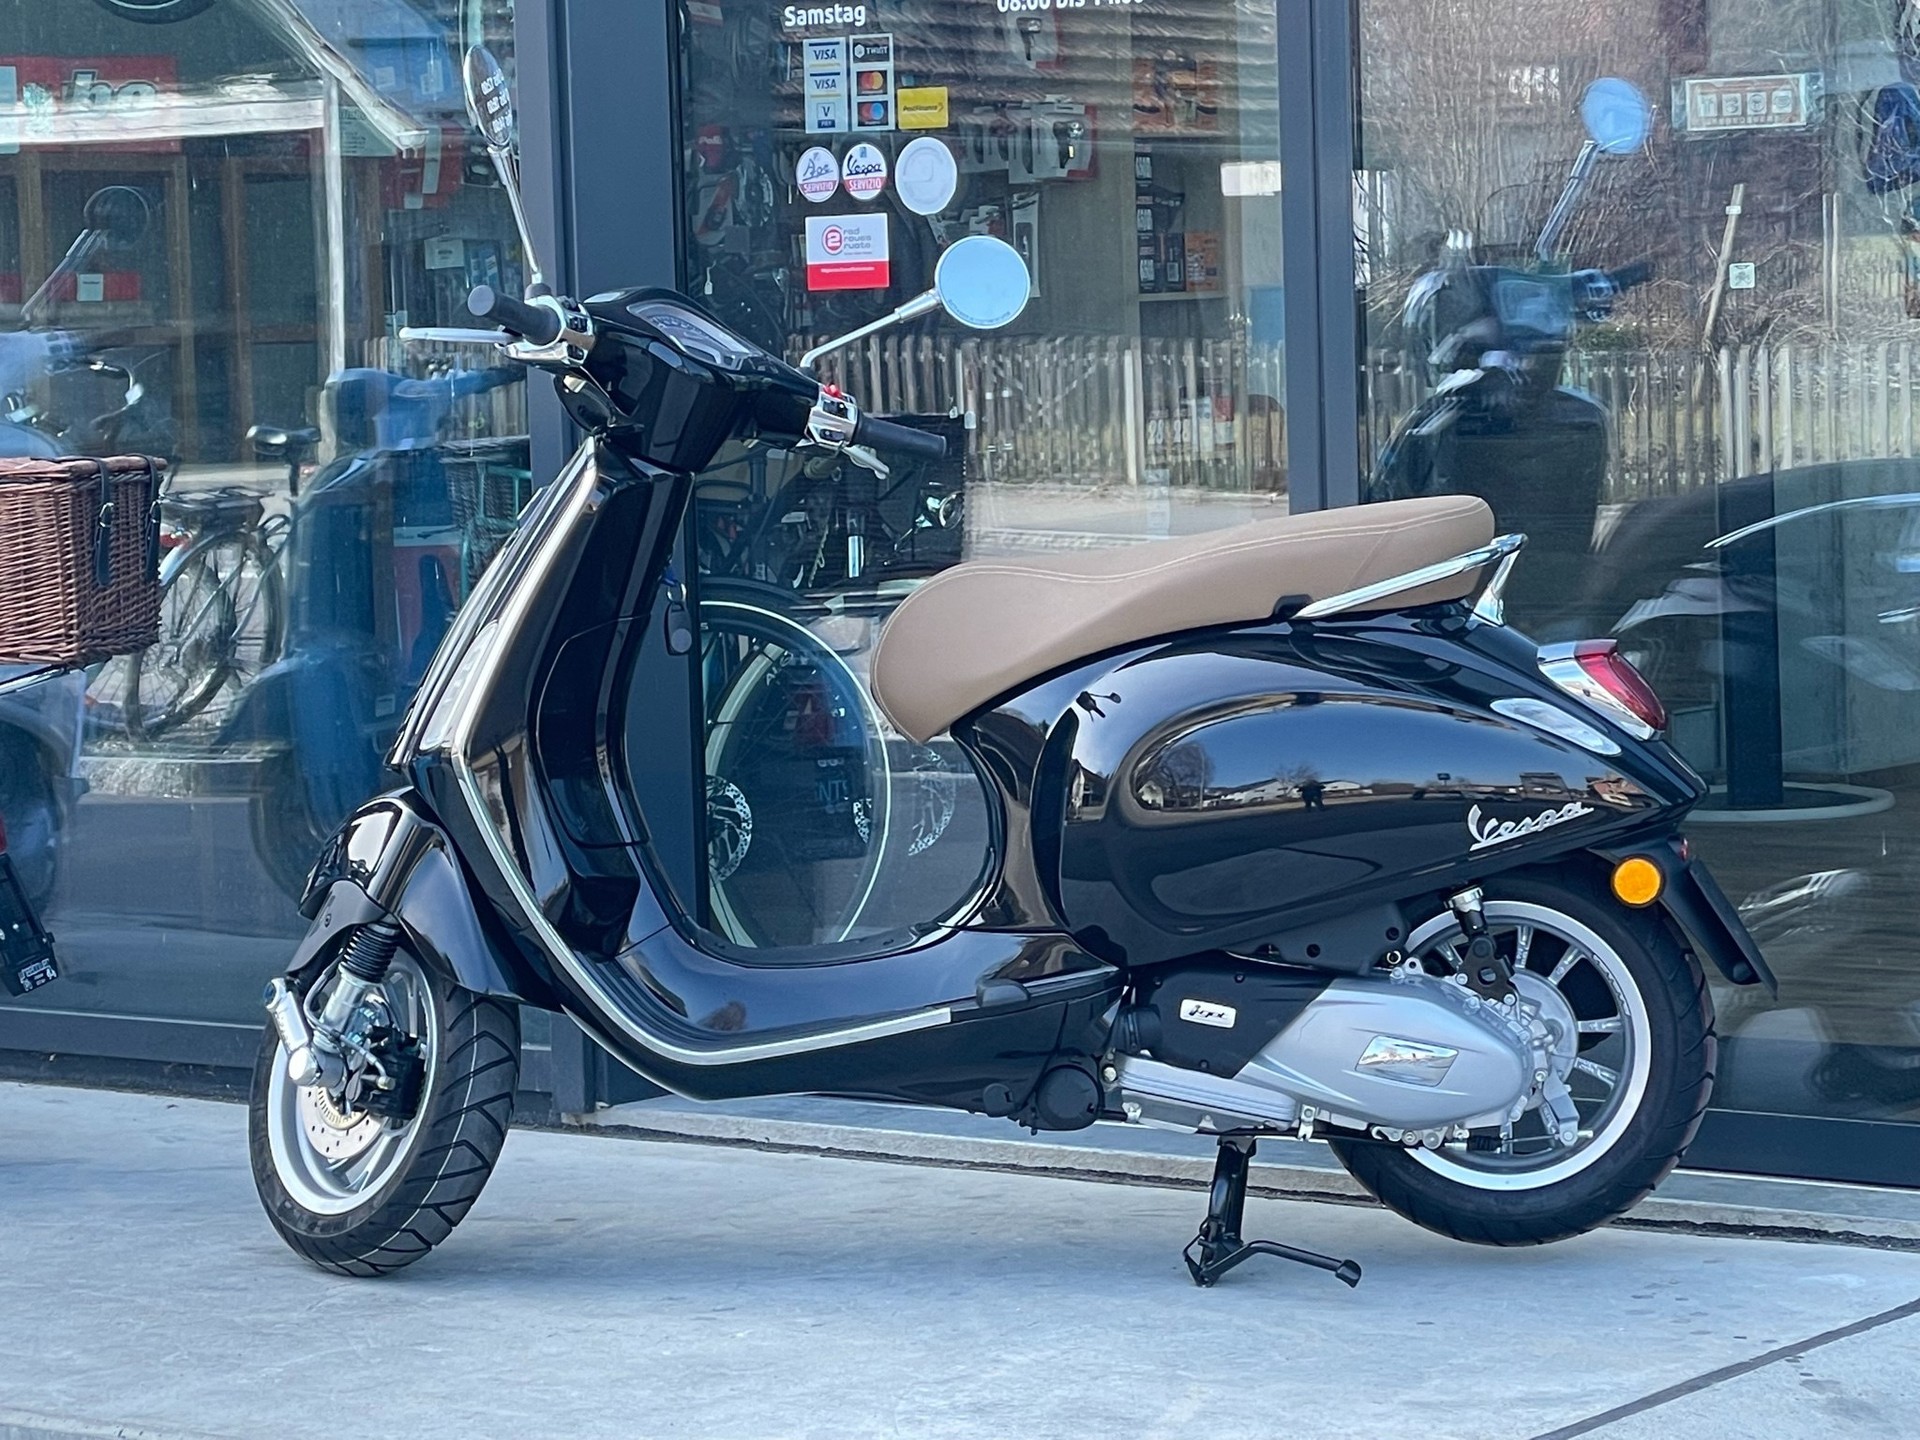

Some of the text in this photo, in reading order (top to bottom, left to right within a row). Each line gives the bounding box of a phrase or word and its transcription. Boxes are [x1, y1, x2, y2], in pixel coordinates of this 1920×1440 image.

[784, 3, 866, 27] Samstag
[813, 49, 837, 60] VISA
[814, 78, 837, 90] VISA
[822, 106, 831, 117] V
[846, 154, 883, 177] Vespa
[804, 182, 834, 193] SERVIZIO
[849, 177, 882, 190] SERVIZIO
[1467, 801, 1595, 852] Vespa
